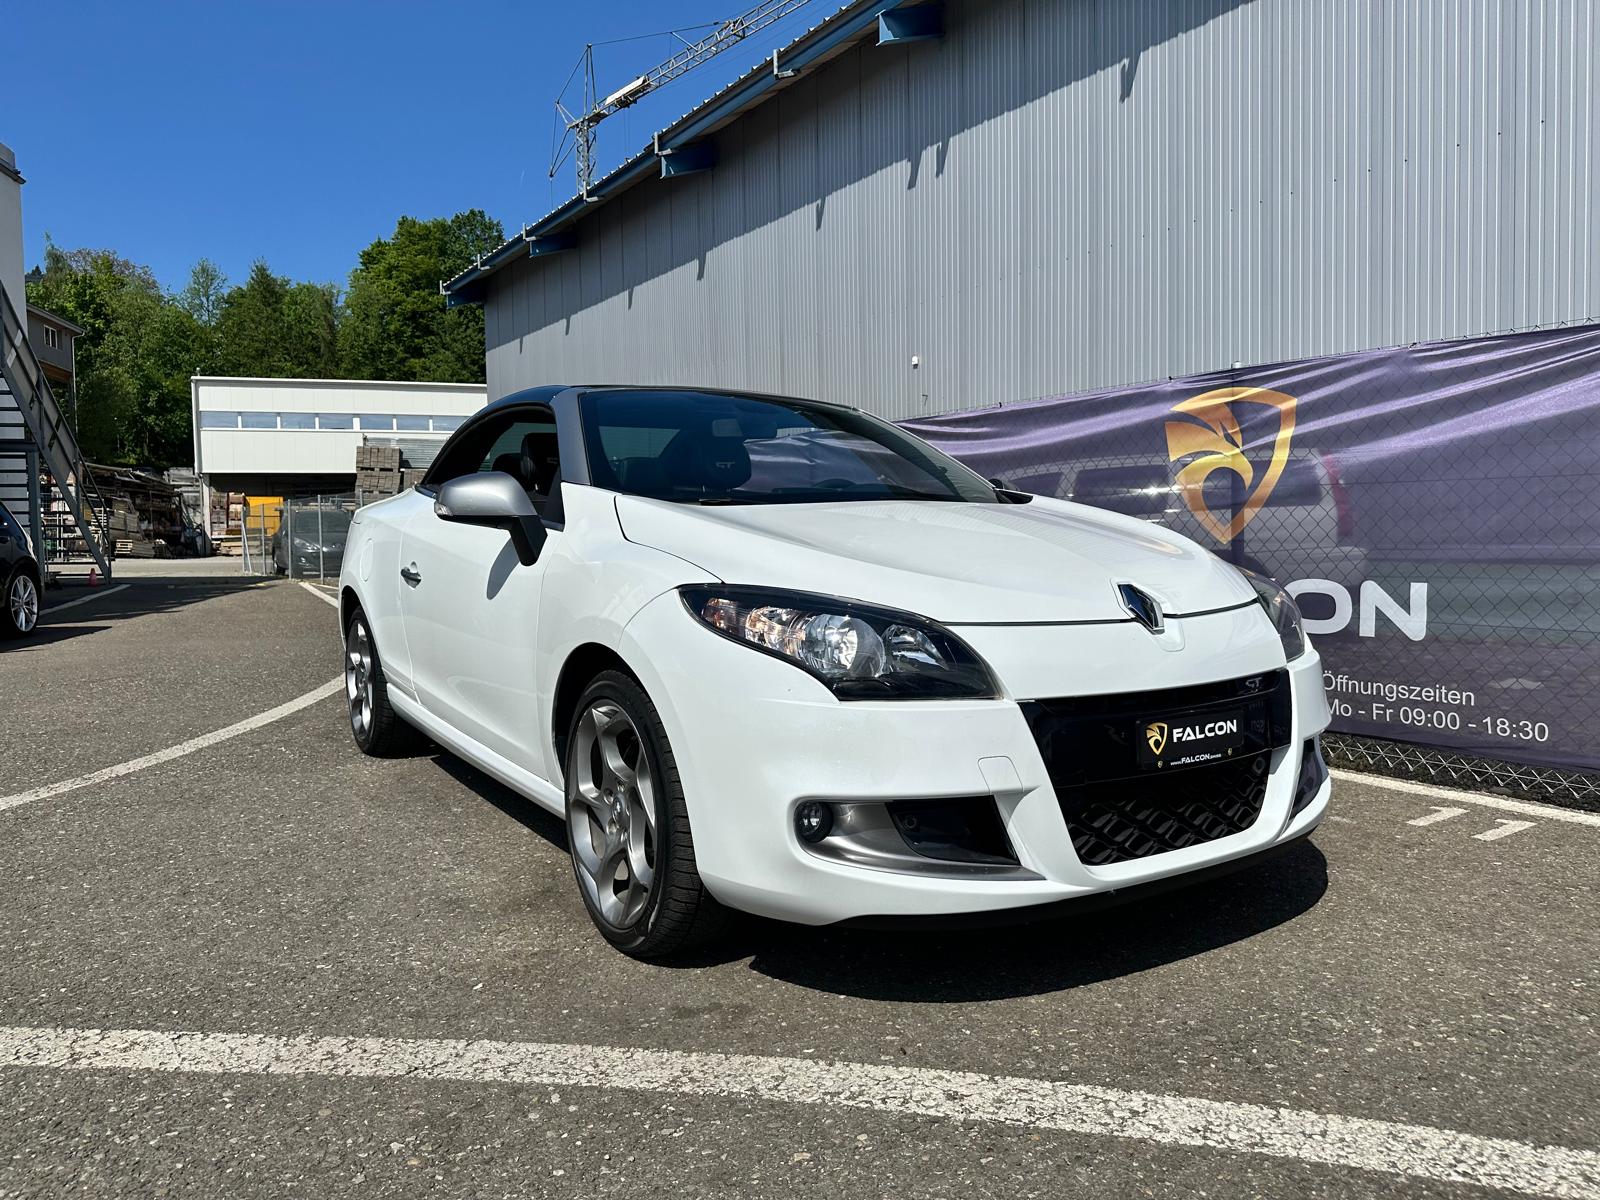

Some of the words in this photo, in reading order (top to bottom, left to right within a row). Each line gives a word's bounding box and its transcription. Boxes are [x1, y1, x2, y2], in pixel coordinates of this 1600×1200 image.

[1270, 578, 1428, 641] ON
[1323, 670, 1475, 706] Öffnungszeiten
[1172, 719, 1238, 743] FALCON
[1372, 703, 1394, 721] Fr
[1400, 706, 1460, 730] 09:00
[1482, 716, 1549, 742] 18:30
